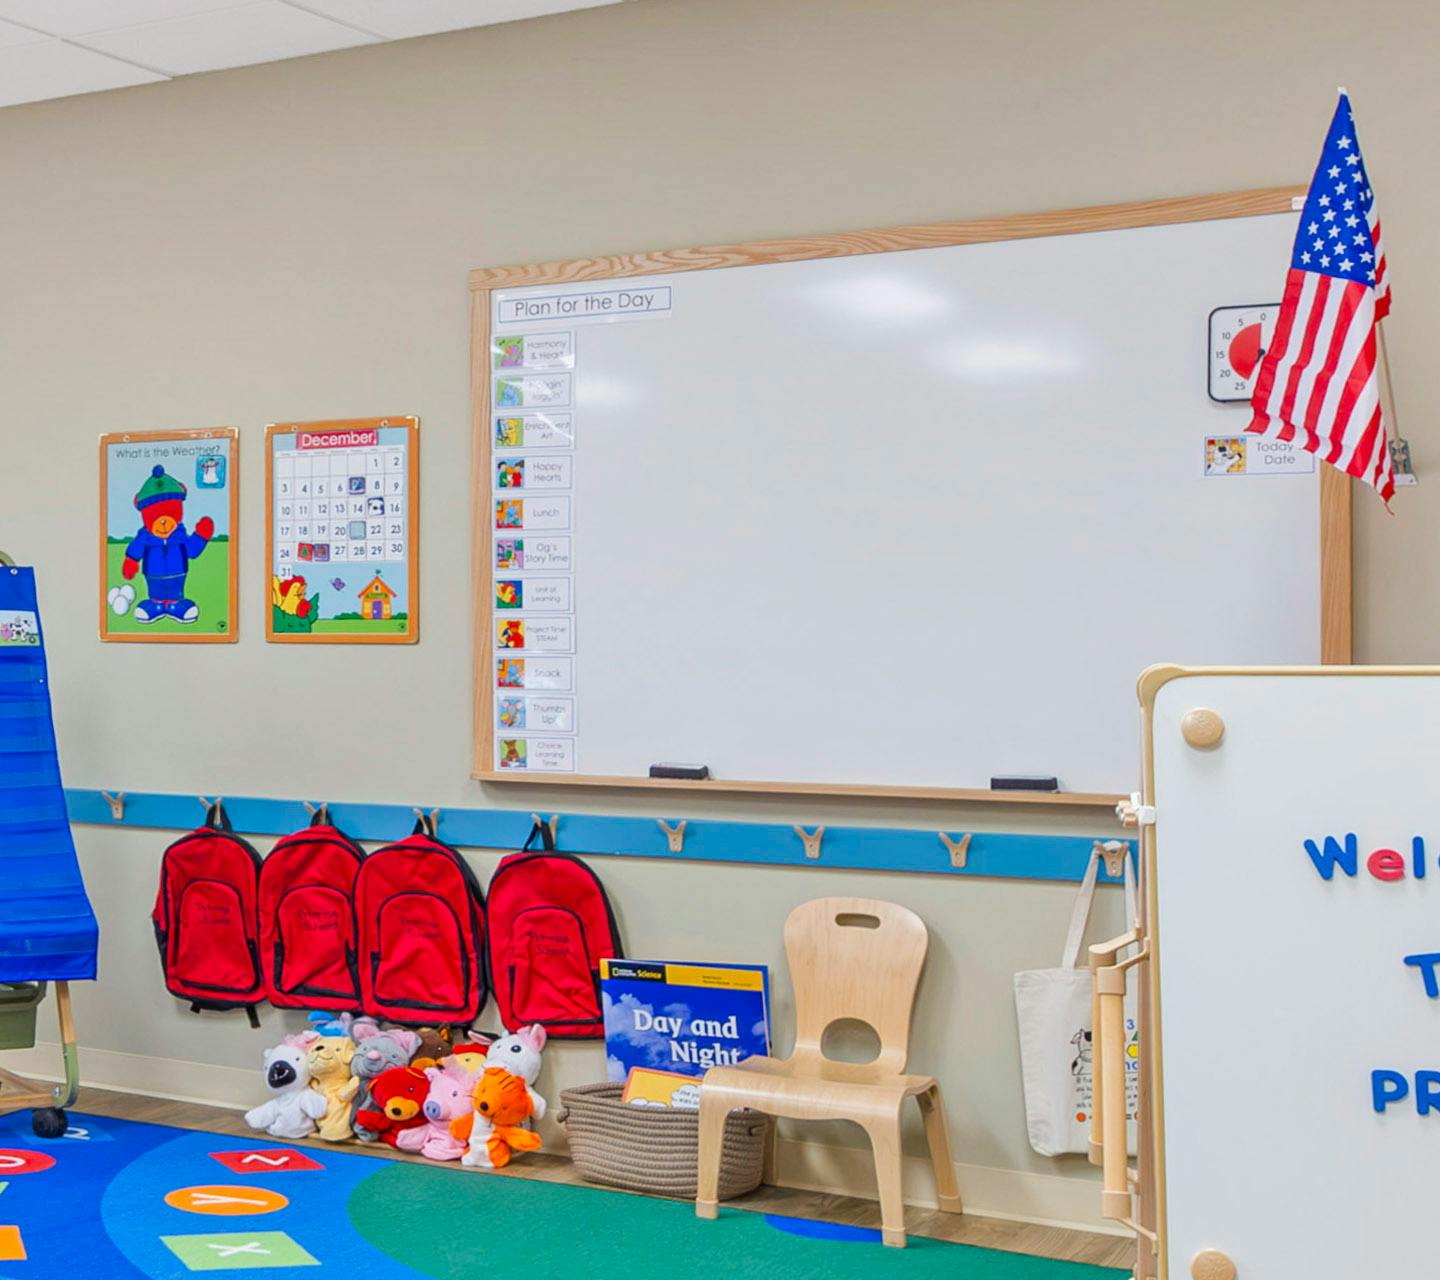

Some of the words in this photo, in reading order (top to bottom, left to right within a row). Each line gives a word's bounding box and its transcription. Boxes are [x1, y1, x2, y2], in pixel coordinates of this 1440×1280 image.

[515, 301, 550, 317] Plan
[557, 298, 578, 313] for
[585, 296, 613, 310] the
[618, 293, 655, 311] Day
[527, 341, 566, 350] Harmony
[1220, 370, 1231, 378] 20
[1235, 383, 1245, 391] 25
[302, 431, 373, 446] December
[115, 449, 142, 459] What
[144, 450, 151, 458] is
[153, 448, 169, 457] the
[172, 445, 220, 456] Weather?
[394, 457, 399, 466] 2
[1264, 455, 1295, 465] Date
[533, 462, 562, 472] Happy
[534, 474, 561, 482] Hearts
[282, 484, 287, 493] 3
[302, 484, 307, 493] 4
[318, 485, 323, 493] 5
[337, 483, 342, 492] 6
[374, 481, 379, 490] 8
[394, 482, 399, 491] 9
[282, 506, 290, 515] 10
[299, 506, 307, 514] 11
[318, 505, 327, 513] 12
[336, 504, 345, 513] 13
[353, 504, 363, 513] 14
[390, 504, 399, 512] 16
[533, 508, 559, 517] Lunch
[281, 527, 289, 535] 17
[299, 527, 307, 535] 18
[317, 525, 325, 534] 19
[335, 526, 345, 535] 20
[371, 526, 381, 534] 22
[391, 525, 401, 534] 23
[280, 549, 289, 558] 24
[335, 546, 345, 555] 27
[353, 547, 365, 556] 28
[371, 546, 382, 555] 29
[391, 544, 402, 553] 30
[526, 554, 546, 563] Story
[548, 554, 568, 562] Time
[281, 568, 291, 577] 31
[535, 668, 560, 677] Snack
[633, 1008, 683, 1038] Day
[690, 1016, 739, 1039] and
[1126, 1019, 1135, 1030] 3
[670, 1040, 741, 1069] Night
[207, 1242, 271, 1257] x
